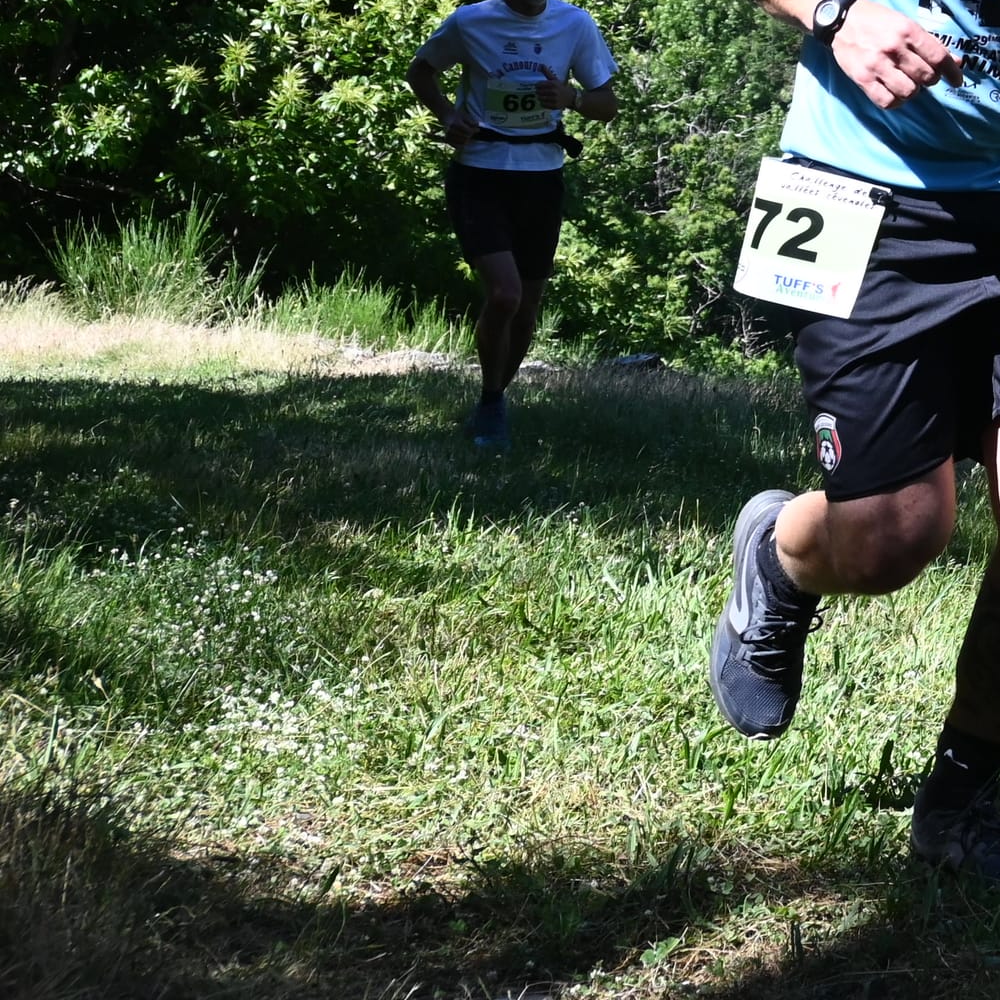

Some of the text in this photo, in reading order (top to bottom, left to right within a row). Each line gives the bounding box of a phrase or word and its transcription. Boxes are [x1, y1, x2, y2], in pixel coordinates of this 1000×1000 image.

[854, 187, 868, 197] de
[750, 197, 825, 263] 72
[774, 273, 825, 295] TUFF'S
